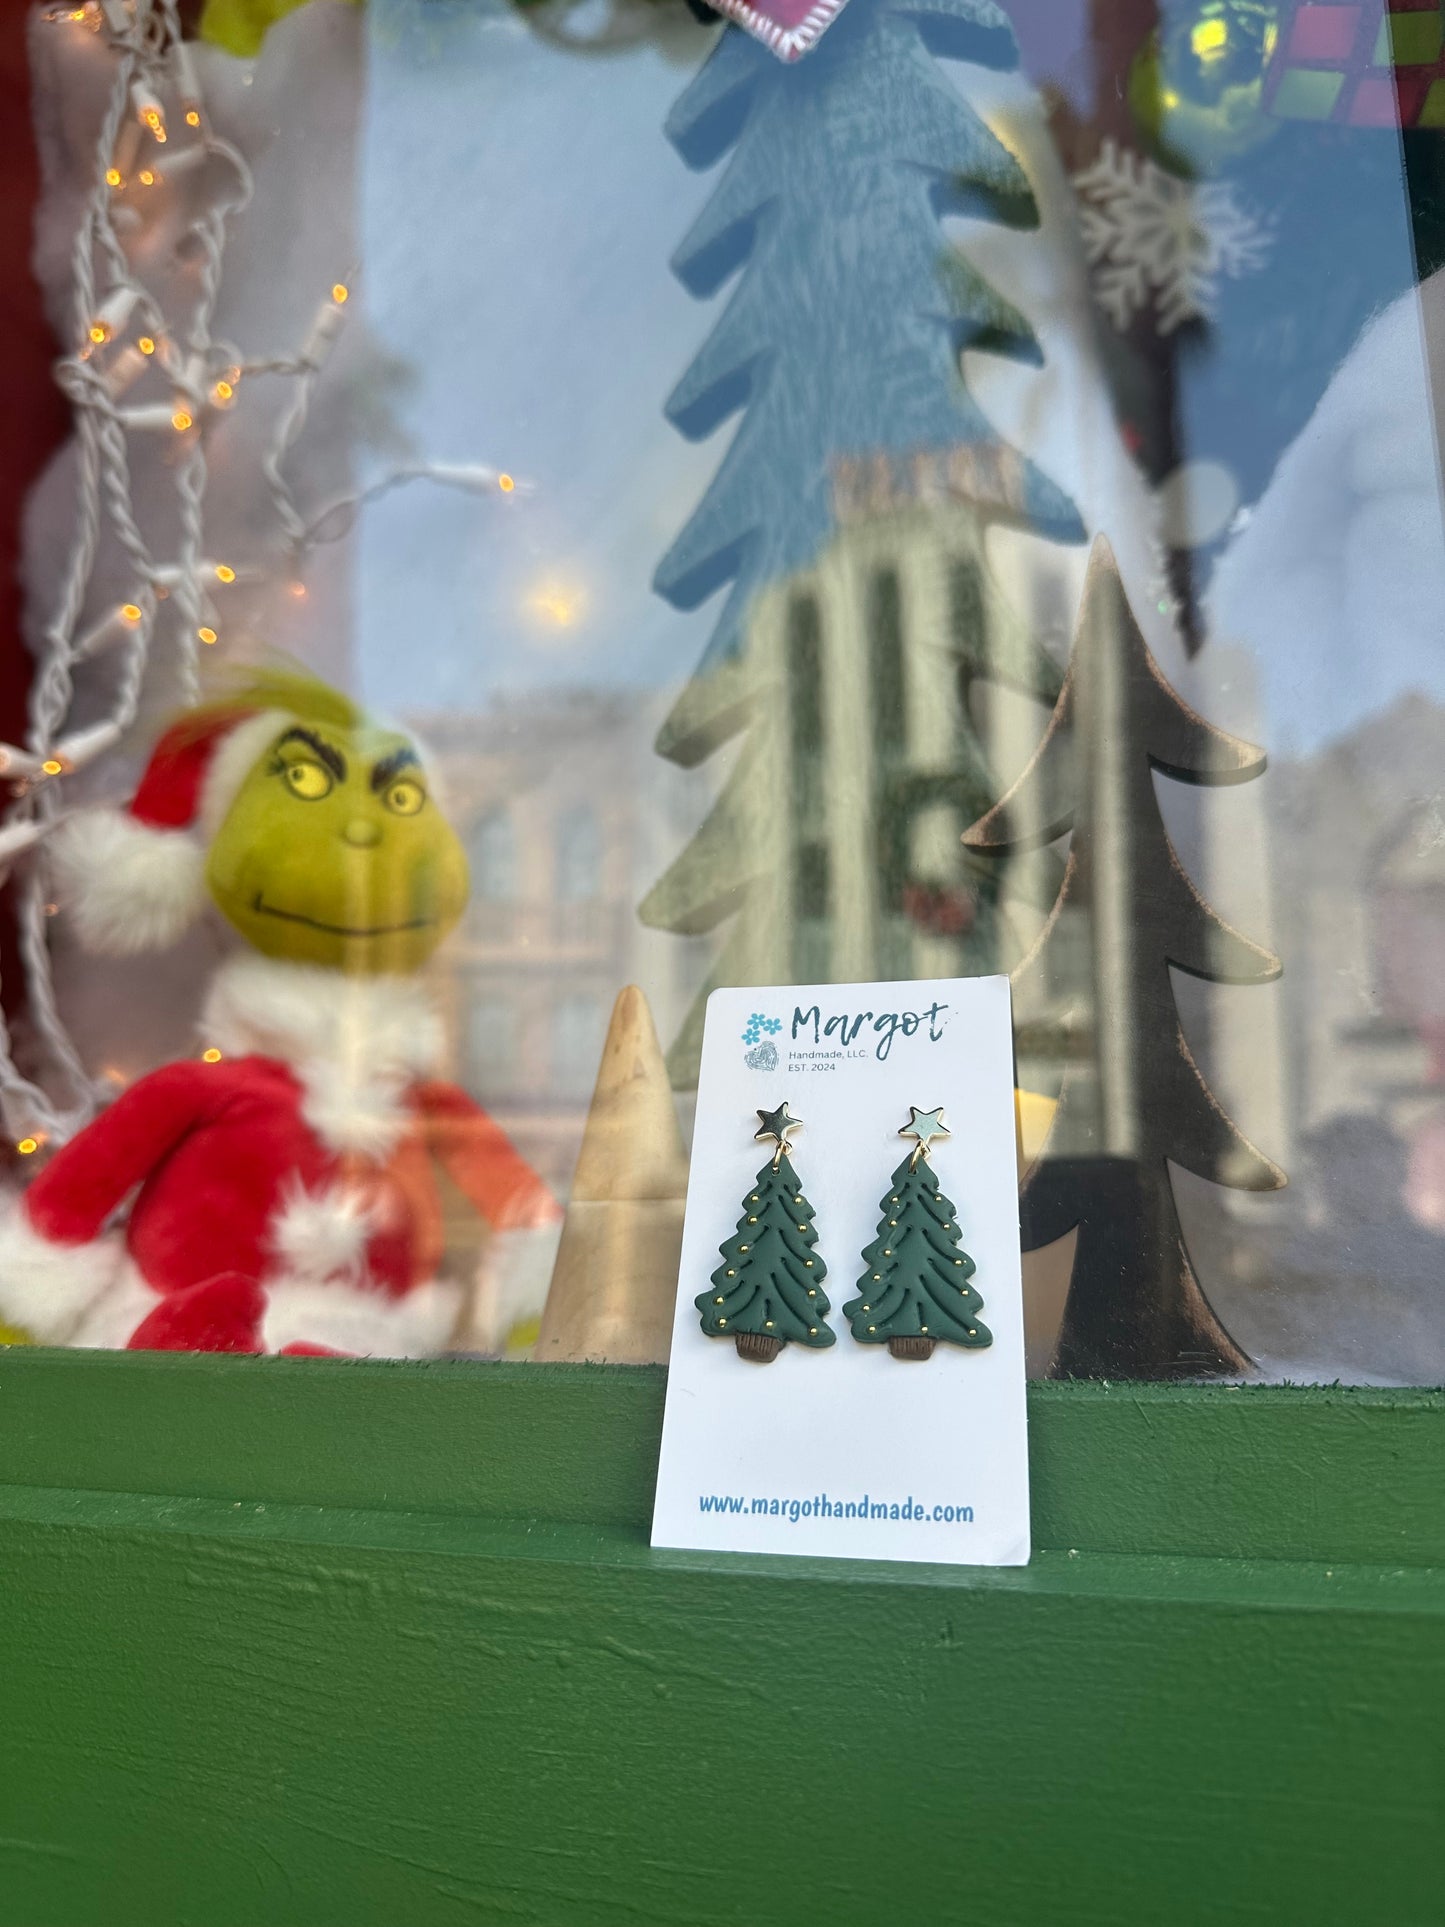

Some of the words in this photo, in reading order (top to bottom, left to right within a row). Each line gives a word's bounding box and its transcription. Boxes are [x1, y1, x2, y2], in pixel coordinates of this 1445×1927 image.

[790, 1002, 949, 1061] Margot
[789, 1050, 845, 1060] Handmade,
[847, 1050, 869, 1058] LLC.
[788, 1063, 810, 1072] EST.
[811, 1063, 836, 1072] 2024
[699, 1493, 974, 1523] www.margothandmade.com
